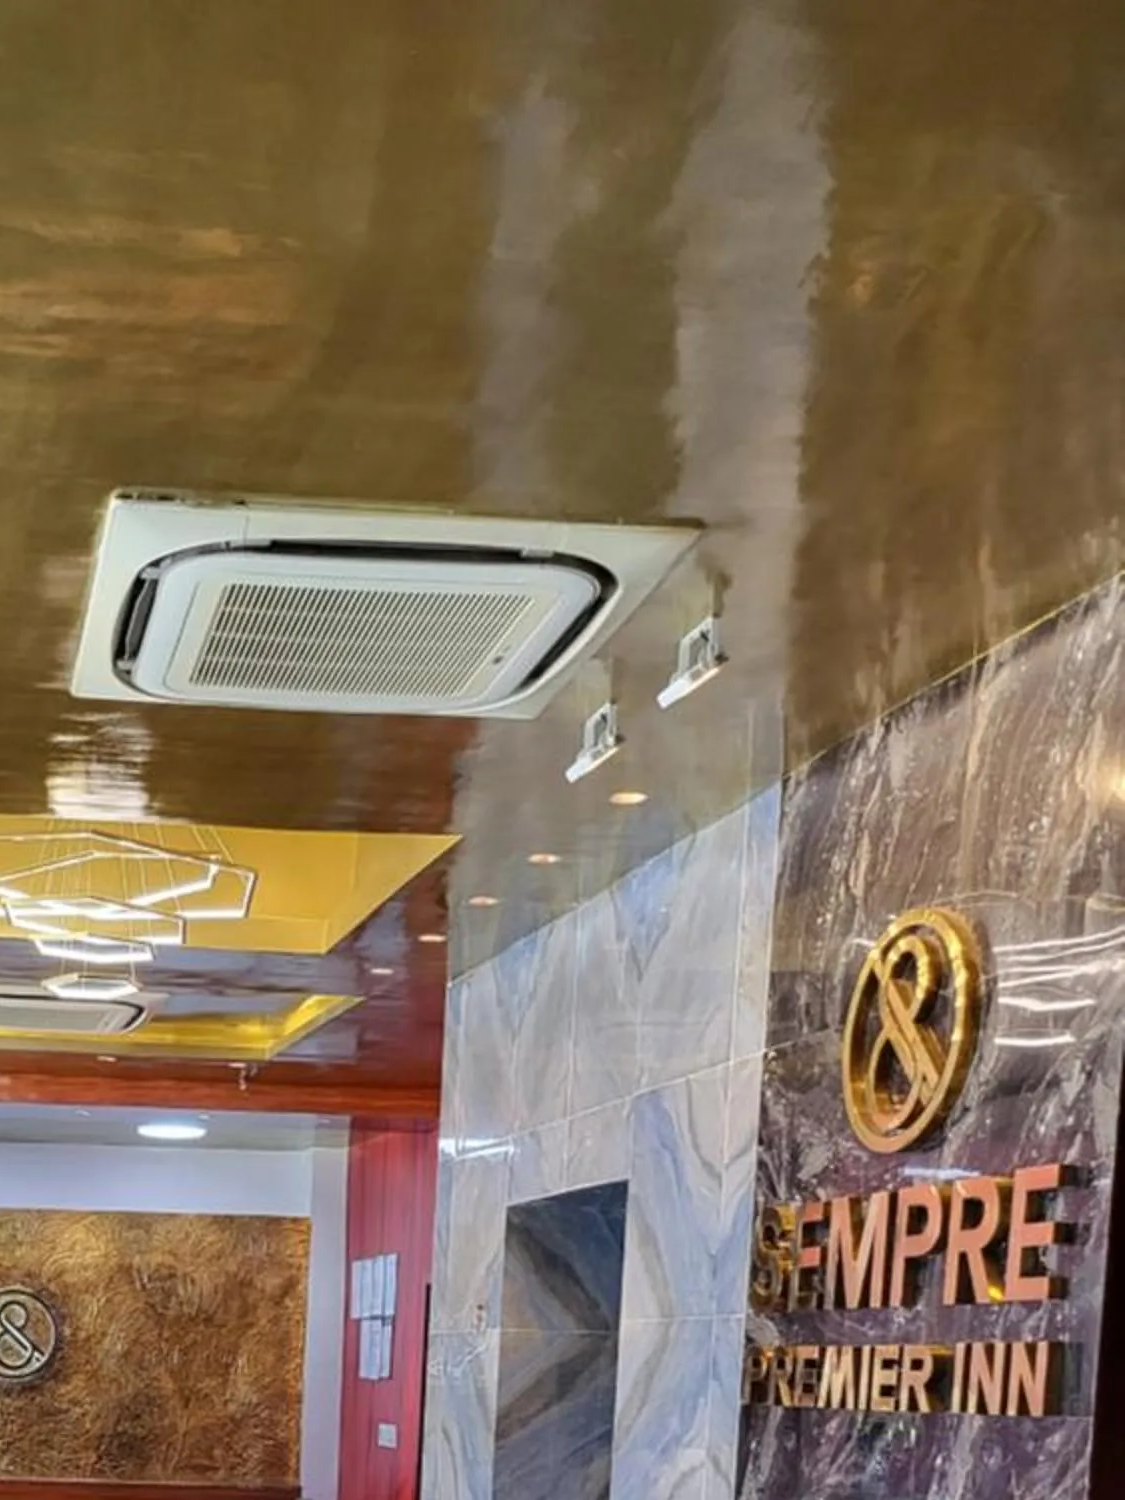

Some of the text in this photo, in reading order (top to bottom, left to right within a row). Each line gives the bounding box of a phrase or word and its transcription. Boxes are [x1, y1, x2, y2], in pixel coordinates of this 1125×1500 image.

[750, 1163, 1061, 1312] SEMPRE
[743, 1340, 1049, 1418] PREMIER INN
